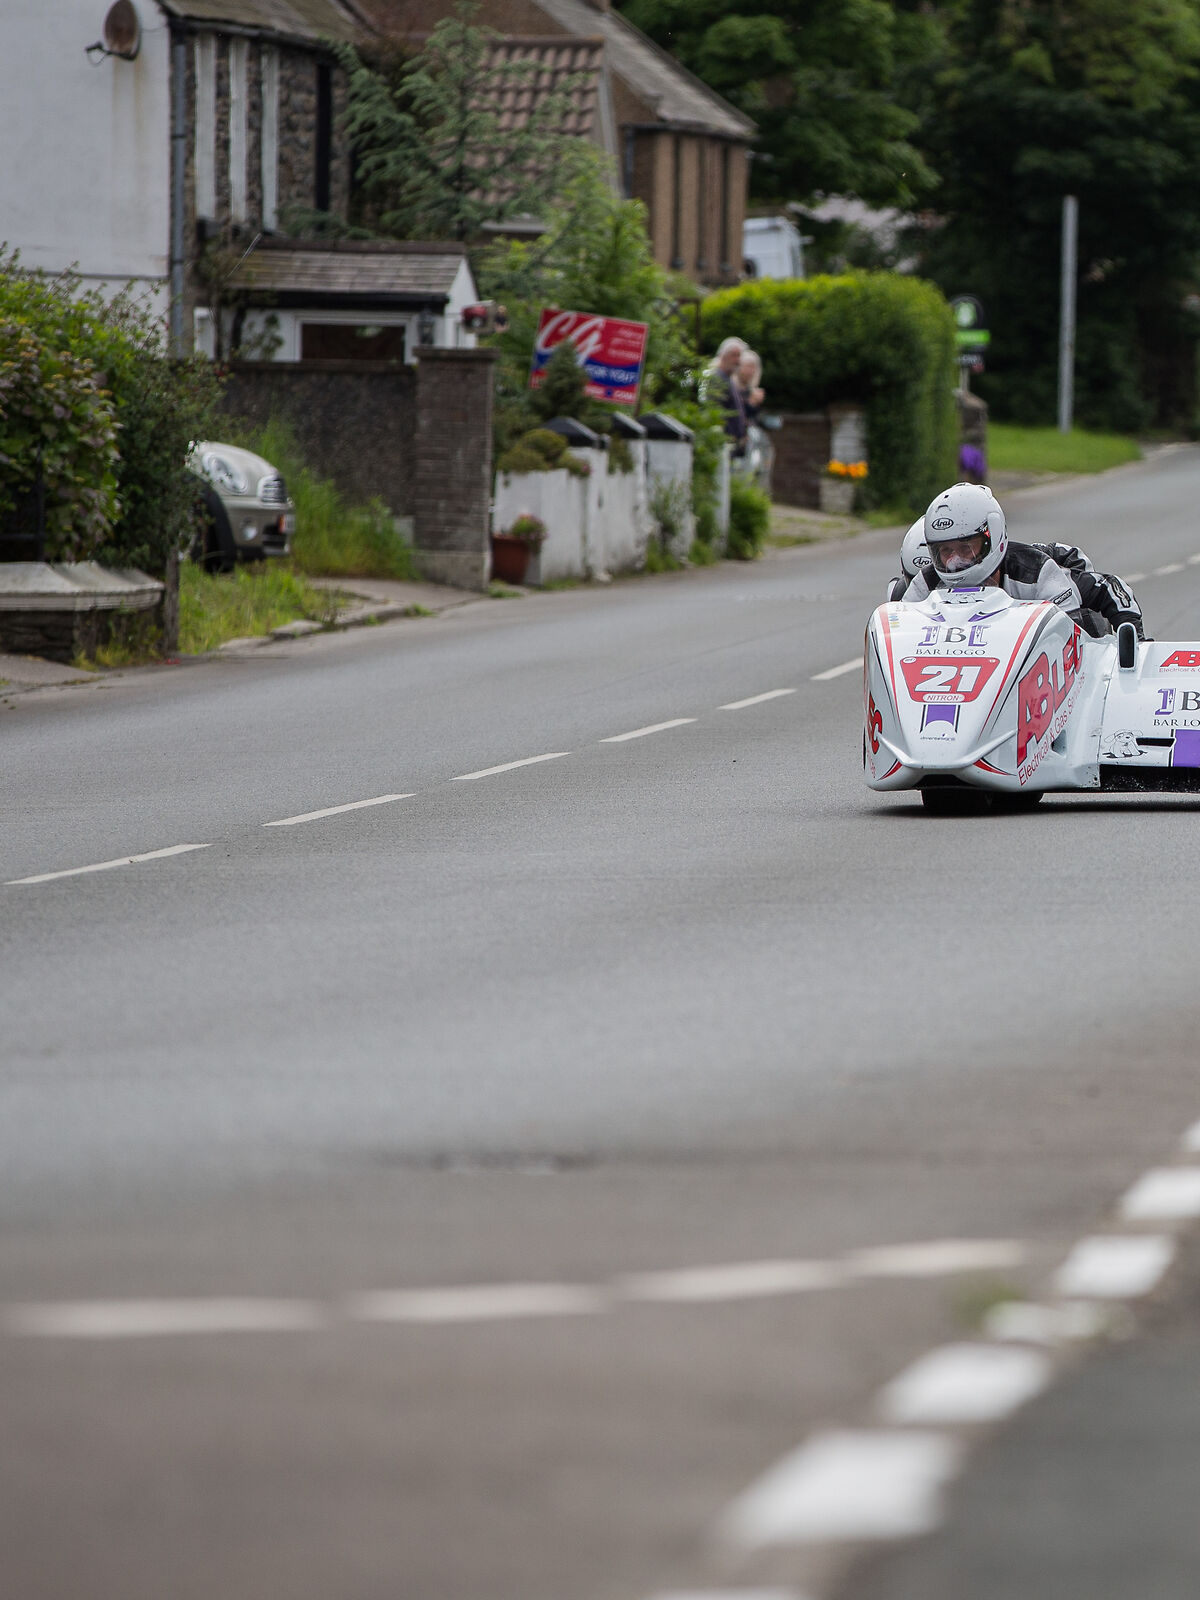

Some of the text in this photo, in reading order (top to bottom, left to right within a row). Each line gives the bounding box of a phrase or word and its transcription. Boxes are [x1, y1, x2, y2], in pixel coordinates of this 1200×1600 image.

[933, 519, 952, 529] Arai
[914, 665, 982, 693] 21
[1017, 623, 1083, 768] ABLEC
[1153, 719, 1179, 727] BAR
[1018, 734, 1049, 786] Electrical
[1055, 710, 1068, 734] Gas
